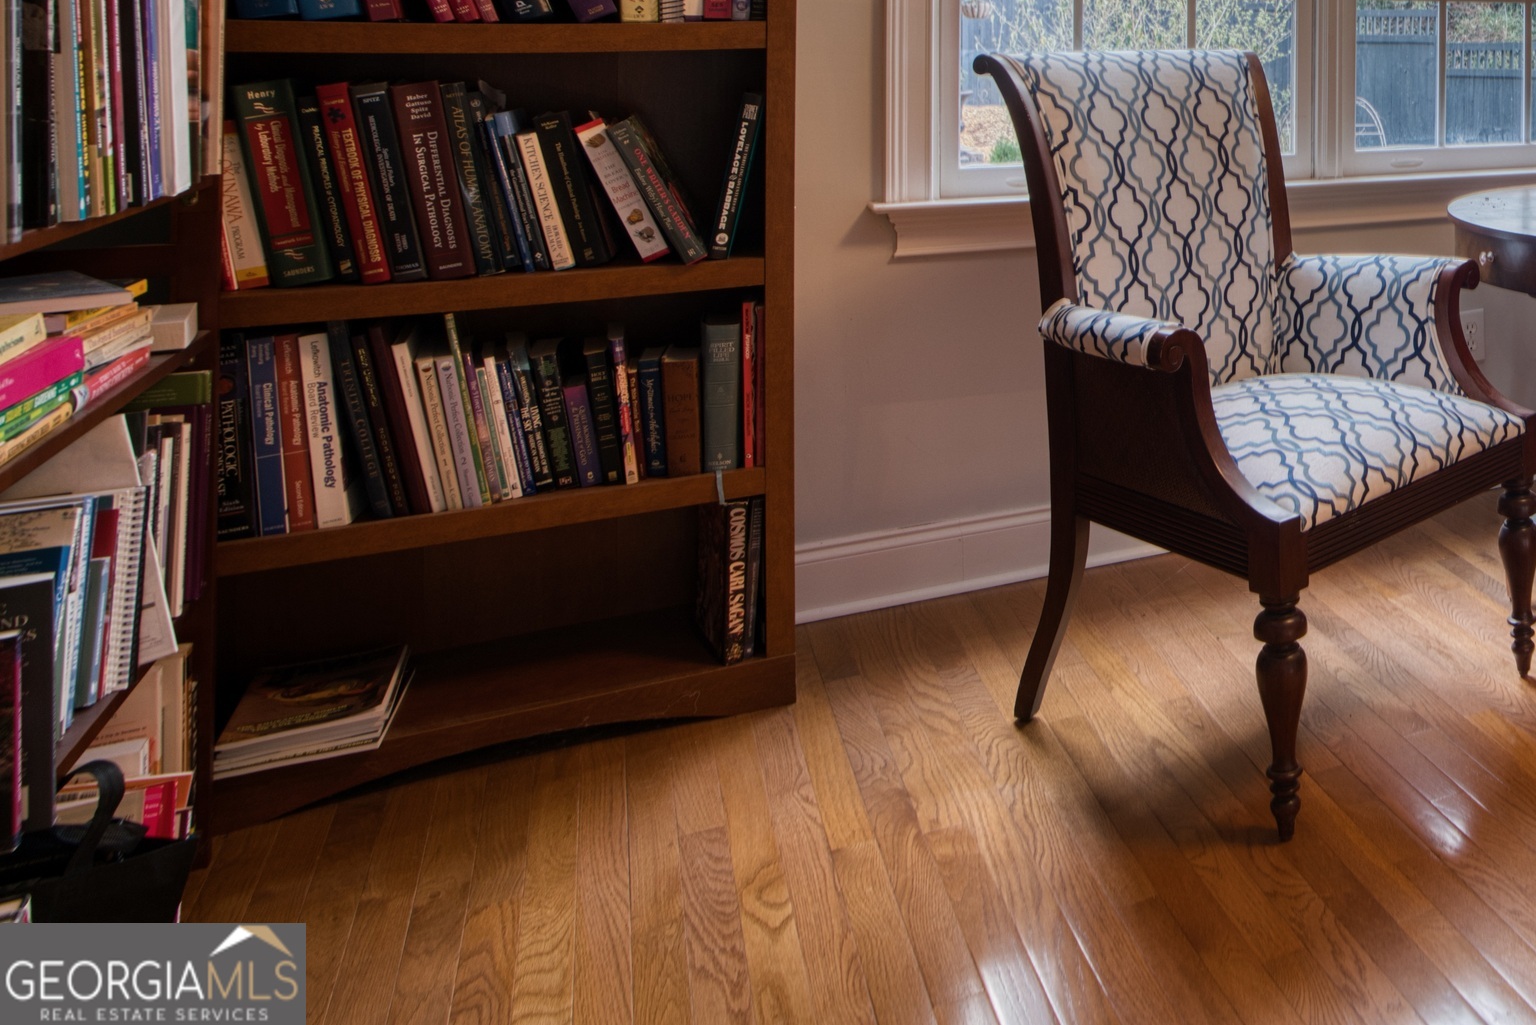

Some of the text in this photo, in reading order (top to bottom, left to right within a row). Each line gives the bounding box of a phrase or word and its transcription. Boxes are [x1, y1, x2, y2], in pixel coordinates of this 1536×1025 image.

[247, 88, 276, 100] Henry
[363, 96, 380, 104] SPITZ
[405, 99, 432, 108] Gattuso
[406, 93, 428, 102] Haber
[410, 112, 432, 120] David
[411, 106, 428, 114] Spitz
[259, 131, 273, 166] Laboratory
[266, 165, 280, 194] Methods
[426, 130, 458, 250] DIFFERENTIAL DIAGNOSIS
[451, 105, 494, 260] ATLAS OF HUMAN ANATOMY
[523, 137, 554, 225] KITCHEN SCIENCE
[611, 180, 630, 194] Bread
[718, 121, 749, 230] LOVELACE BABBAGE
[222, 160, 244, 224] OKINAWA
[341, 128, 382, 264] TEXTBOOK OF PHYSICAL DIAGNOSIS
[412, 133, 443, 249] IN SURGICAL PATHOLOGY
[634, 148, 691, 239] ONE WRITER'S GARDEN
[231, 225, 245, 260] PROGRAM
[544, 225, 558, 252] HILLMAN
[552, 224, 563, 249] HOWARD
[283, 265, 316, 278] SAUNDERS
[310, 340, 321, 379] Lefkowitch
[262, 382, 274, 446] Clinical Pathology
[289, 380, 302, 446] Anatomic Pathology
[306, 383, 320, 438] Board Review
[317, 381, 336, 488] Anatomic Pathology
[341, 360, 377, 478] TRINITY COLLEGE
[519, 405, 532, 432] THE SKY
[528, 404, 542, 428] LIVING
[221, 399, 238, 478] PATHOLOGIC
[729, 507, 746, 560] COSMOS
[728, 560, 746, 636] CARL SAGAN
